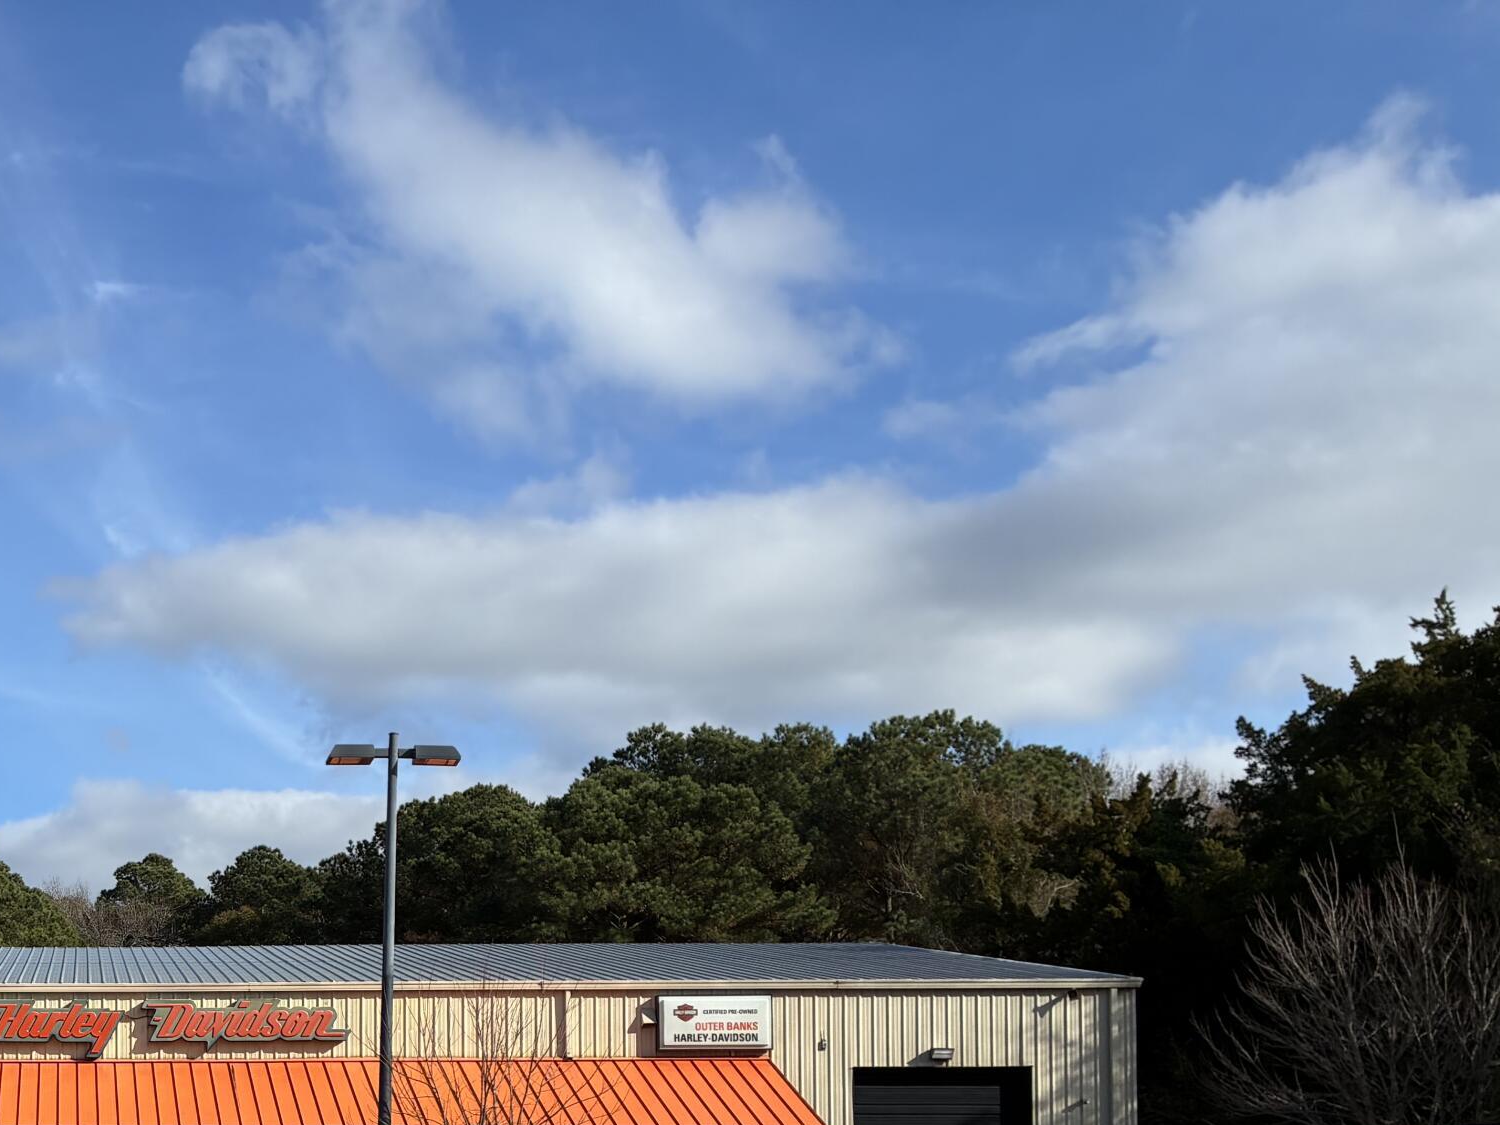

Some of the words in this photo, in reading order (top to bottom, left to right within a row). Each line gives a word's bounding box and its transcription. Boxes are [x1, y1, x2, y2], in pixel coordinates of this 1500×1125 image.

[695, 1022, 725, 1031] OUTER
[726, 1022, 759, 1031] BANKS
[674, 1033, 759, 1042] HARLEY-DAVIDSON
